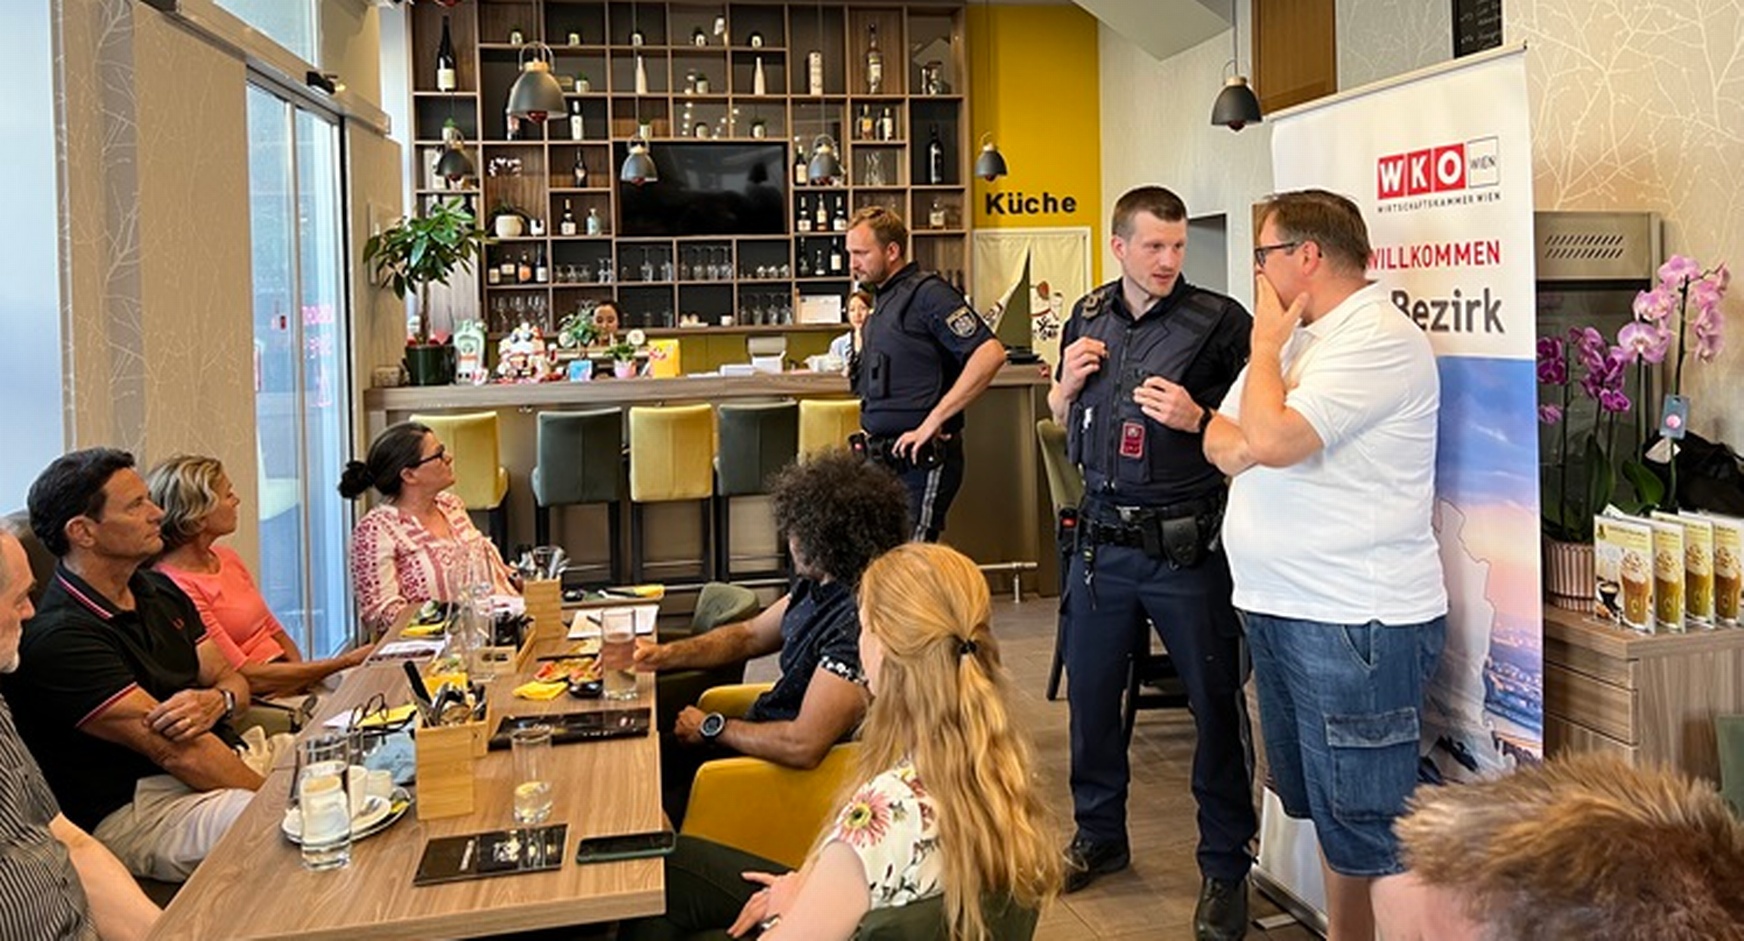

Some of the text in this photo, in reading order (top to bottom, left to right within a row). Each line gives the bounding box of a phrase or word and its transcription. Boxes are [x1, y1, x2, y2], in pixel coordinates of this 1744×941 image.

[1379, 149, 1497, 194] WKO WIEN
[985, 192, 1077, 215] Küche
[1377, 191, 1501, 214] WIRTSCHAFTSKAMMER WIEN
[1367, 240, 1500, 270] WILLKOMMEN
